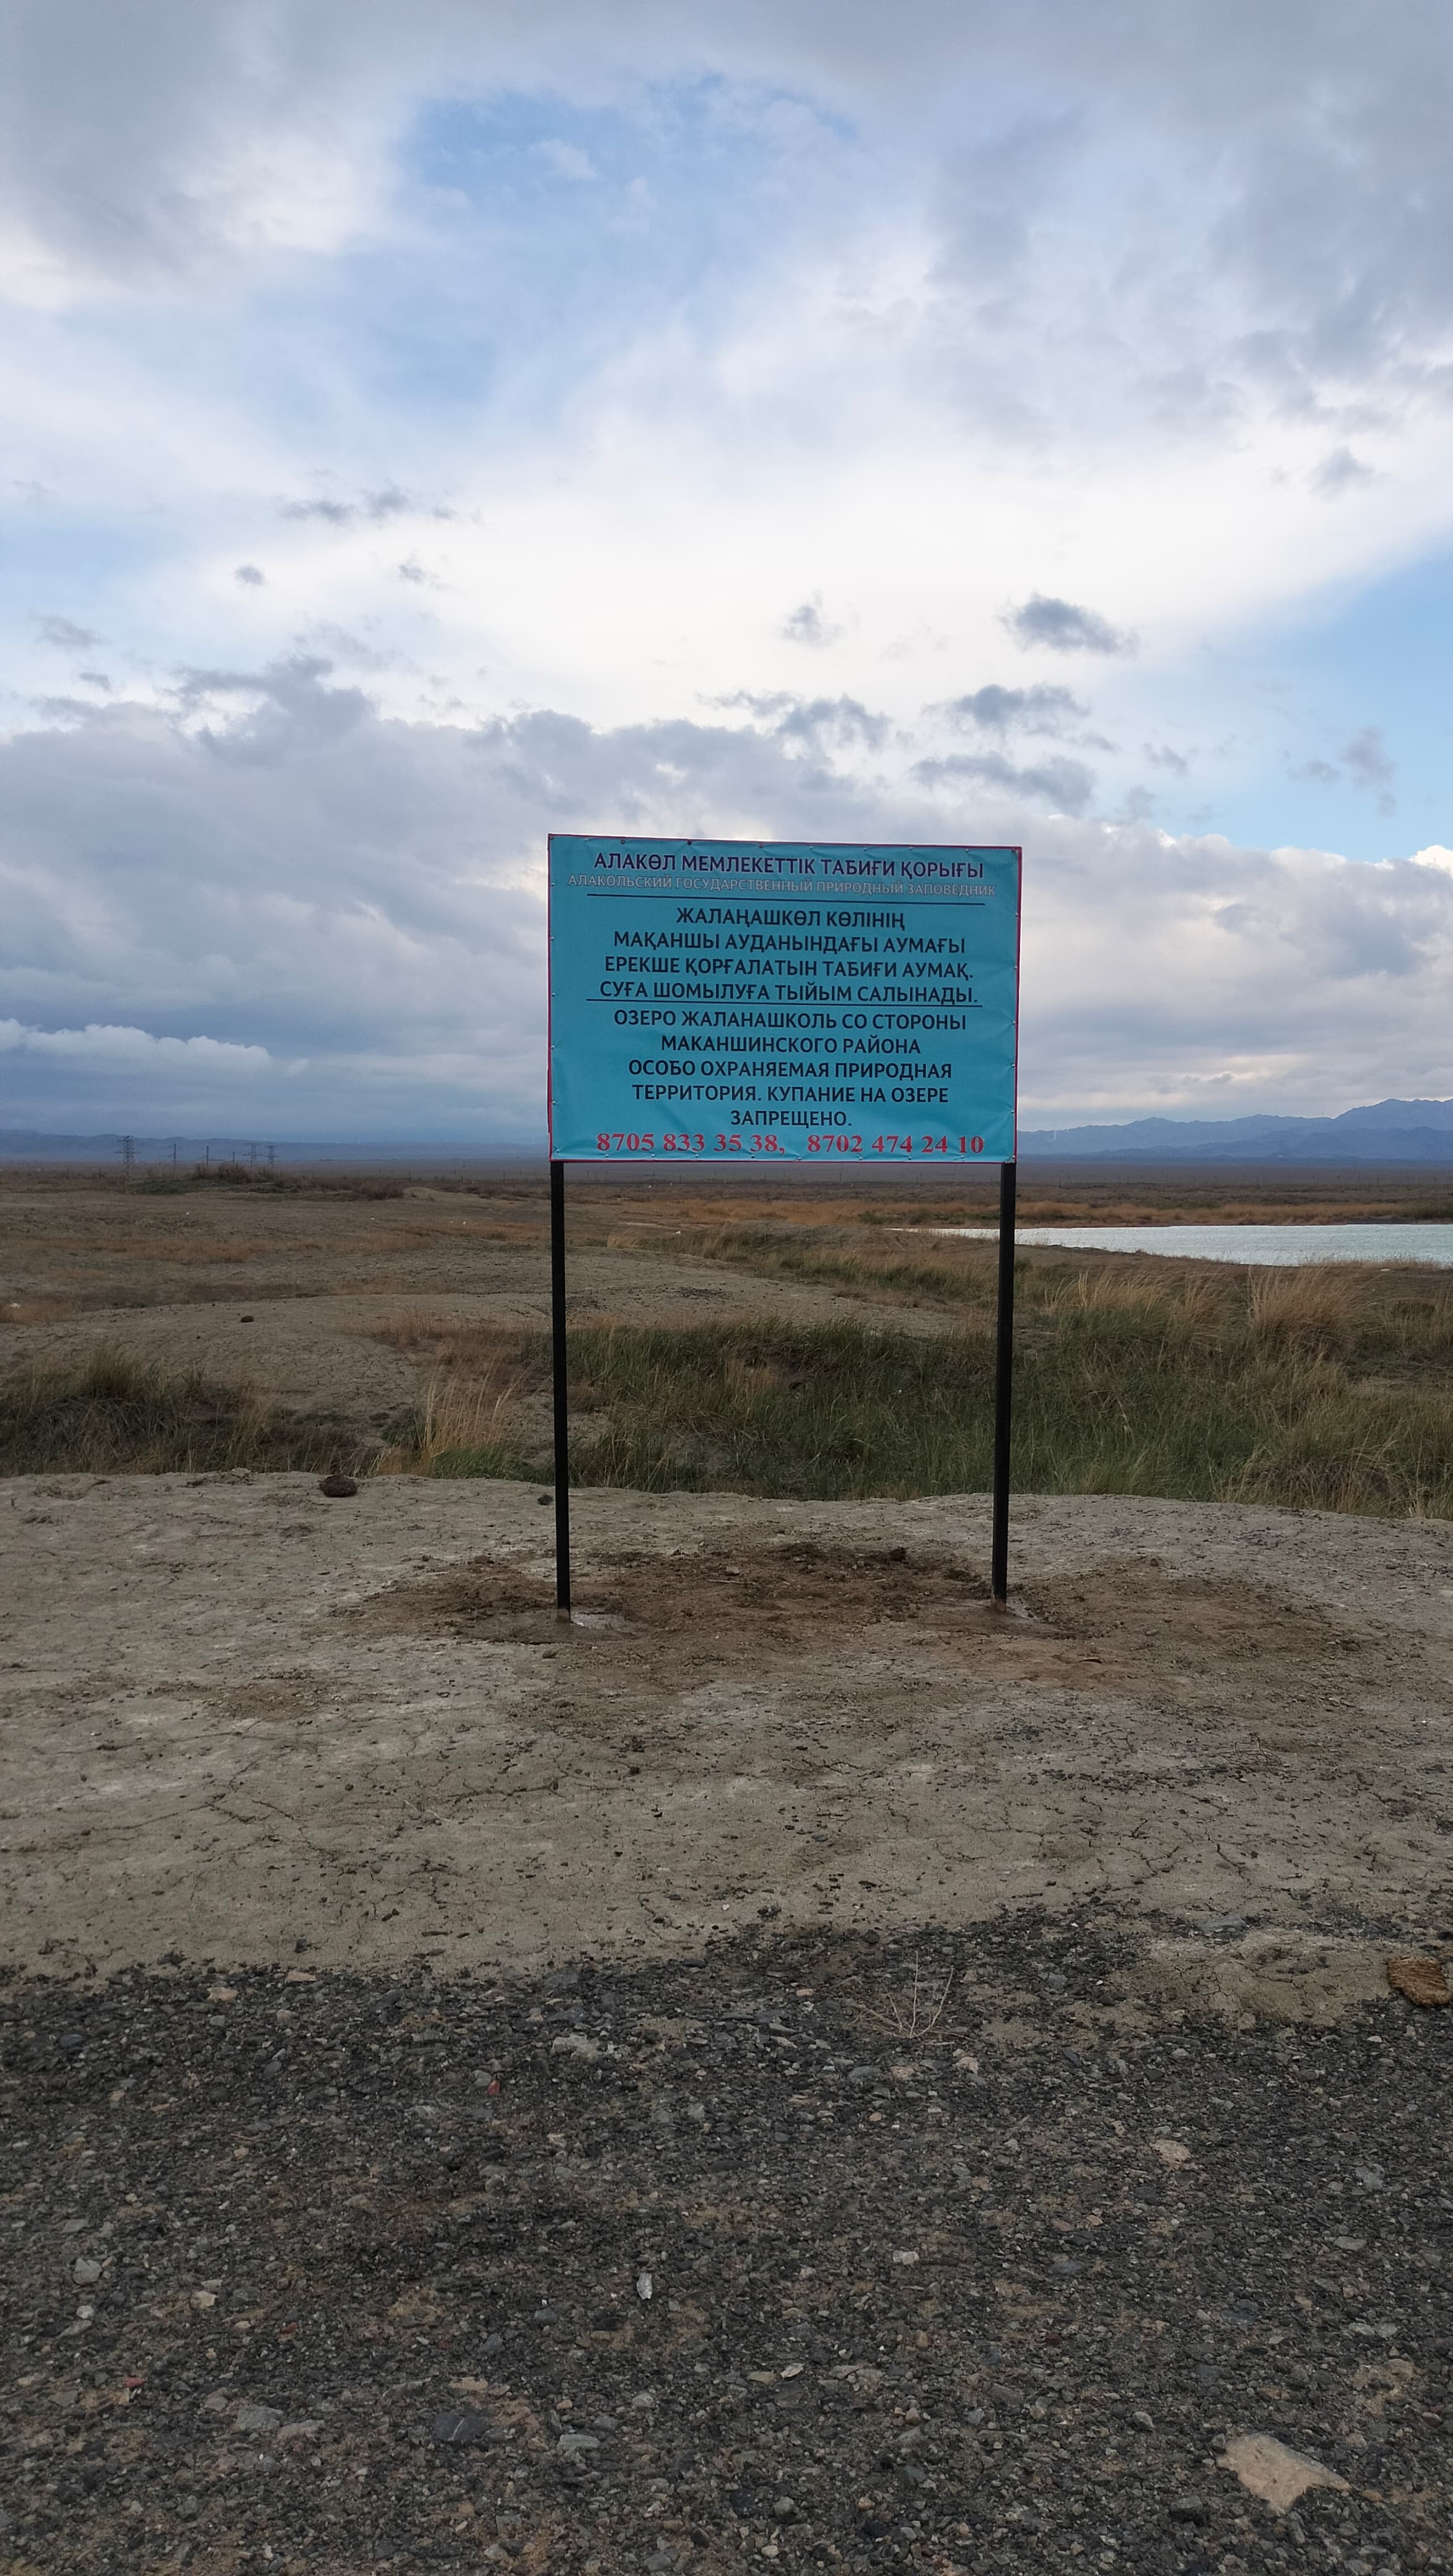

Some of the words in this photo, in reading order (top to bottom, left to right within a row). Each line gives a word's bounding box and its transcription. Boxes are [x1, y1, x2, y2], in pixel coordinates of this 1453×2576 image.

[595, 853, 675, 870] АЛАКӨЛ
[683, 856, 815, 874] МЕМЛЕКЕТТІК
[821, 859, 894, 876] ТАБИҒИ
[901, 861, 983, 879] ҚОРЫҒЫ
[567, 874, 672, 888] АЛАКОЛЬСКИЙ
[676, 877, 813, 892] ГОСУДАРСТВЕННЫЙ
[816, 880, 903, 895] ПРИРОДНЫЙ
[907, 884, 997, 897] ЗАПОВЕДНИК
[676, 908, 820, 927] ЖАЛАҢАШКӨЛ
[827, 912, 905, 931] КӨЛІНІҢ
[614, 931, 719, 951] МАҚАНШЫ
[725, 934, 878, 954] АУДАНЫНДАҒЫ
[883, 938, 964, 953] АУМАҒЫ
[606, 956, 680, 973] ЕРЕКШЕ
[686, 958, 816, 976] ҚОРҒАЛАТЫН
[822, 961, 896, 977] ТАБИҒИ
[902, 962, 973, 981] АУМАҚ.
[600, 981, 648, 997] СУҒА
[654, 982, 770, 999] ШОМЫЛУҒА
[775, 981, 851, 1001] ТЫЙЫМ
[857, 986, 977, 1005] САЛЫНАДЫ.
[614, 1009, 676, 1025] ОЗЕРО
[681, 1011, 837, 1029] ЖАЛАНАШКОЛЬ
[842, 1014, 867, 1029] СО
[873, 1014, 966, 1030] СТОРОНЫ
[661, 1035, 837, 1053] МАКАНШИНСКОГО
[844, 1035, 921, 1053] РАЙОНА
[629, 1060, 696, 1076] ОСОБО
[701, 1061, 829, 1077] ОХРАНЯЕМАЯ
[836, 1063, 951, 1081] ПРИРОДНАЯ
[632, 1085, 761, 1100] ТЕРРИТОРИЯ.
[768, 1086, 855, 1102] КУПАНИЕ
[861, 1087, 886, 1102] НА
[891, 1087, 948, 1102] ОЗЕРЕ
[731, 1110, 852, 1128] ЗАПРЕЩЕНО.
[597, 1133, 654, 1151] 8705
[663, 1134, 704, 1151] 833
[713, 1134, 741, 1151] 35
[748, 1134, 784, 1155] 38,
[808, 1135, 862, 1152] 8702
[872, 1136, 912, 1152] 474
[922, 1136, 948, 1152] 24
[958, 1136, 984, 1153] 10
